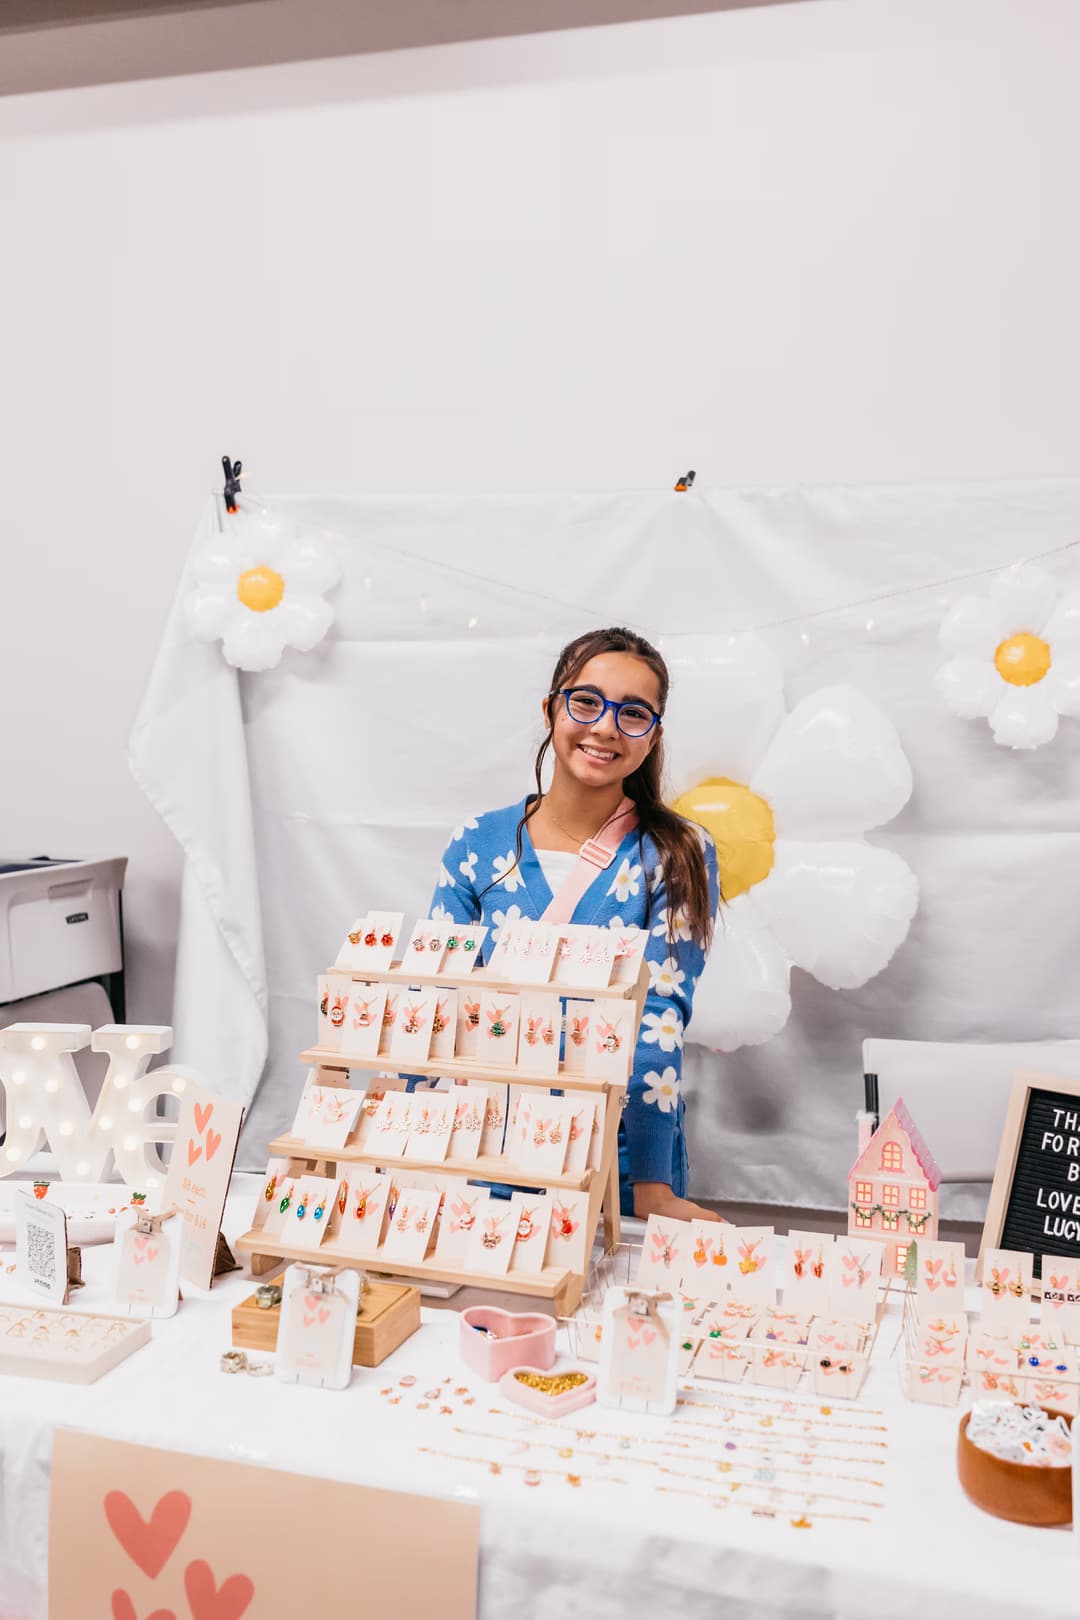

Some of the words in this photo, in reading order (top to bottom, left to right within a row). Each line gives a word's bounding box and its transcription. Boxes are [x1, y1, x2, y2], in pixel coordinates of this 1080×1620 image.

[1053, 1108, 1080, 1132] TH
[1041, 1131, 1080, 1157] FOR
[1036, 1187, 1080, 1216] LOVE
